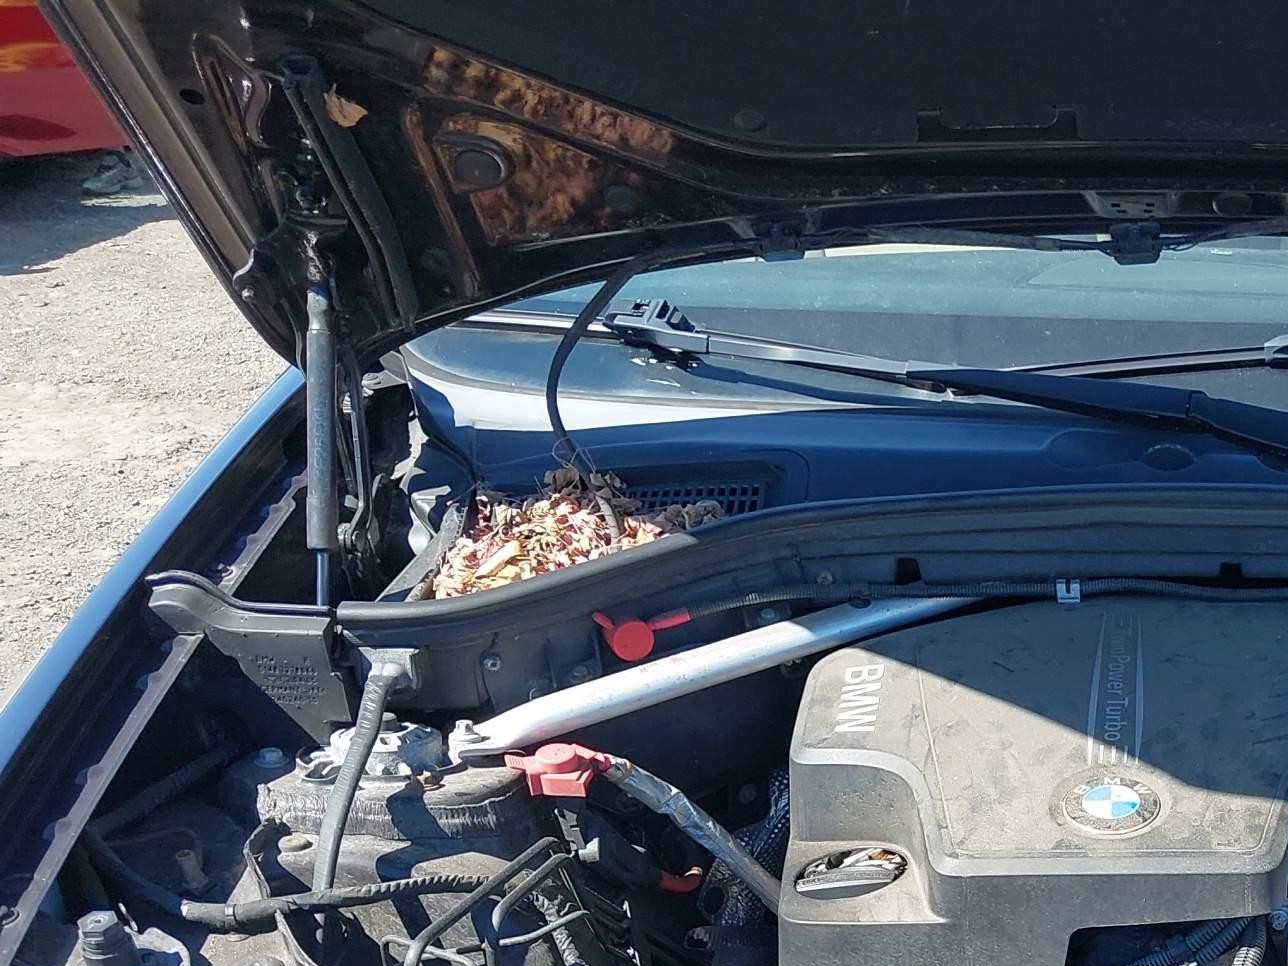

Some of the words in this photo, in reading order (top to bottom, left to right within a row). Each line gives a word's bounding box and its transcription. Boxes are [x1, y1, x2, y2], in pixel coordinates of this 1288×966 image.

[834, 663, 885, 732] BMW
[1104, 697, 1129, 741] Turbo
[1073, 776, 1153, 795] BMW
